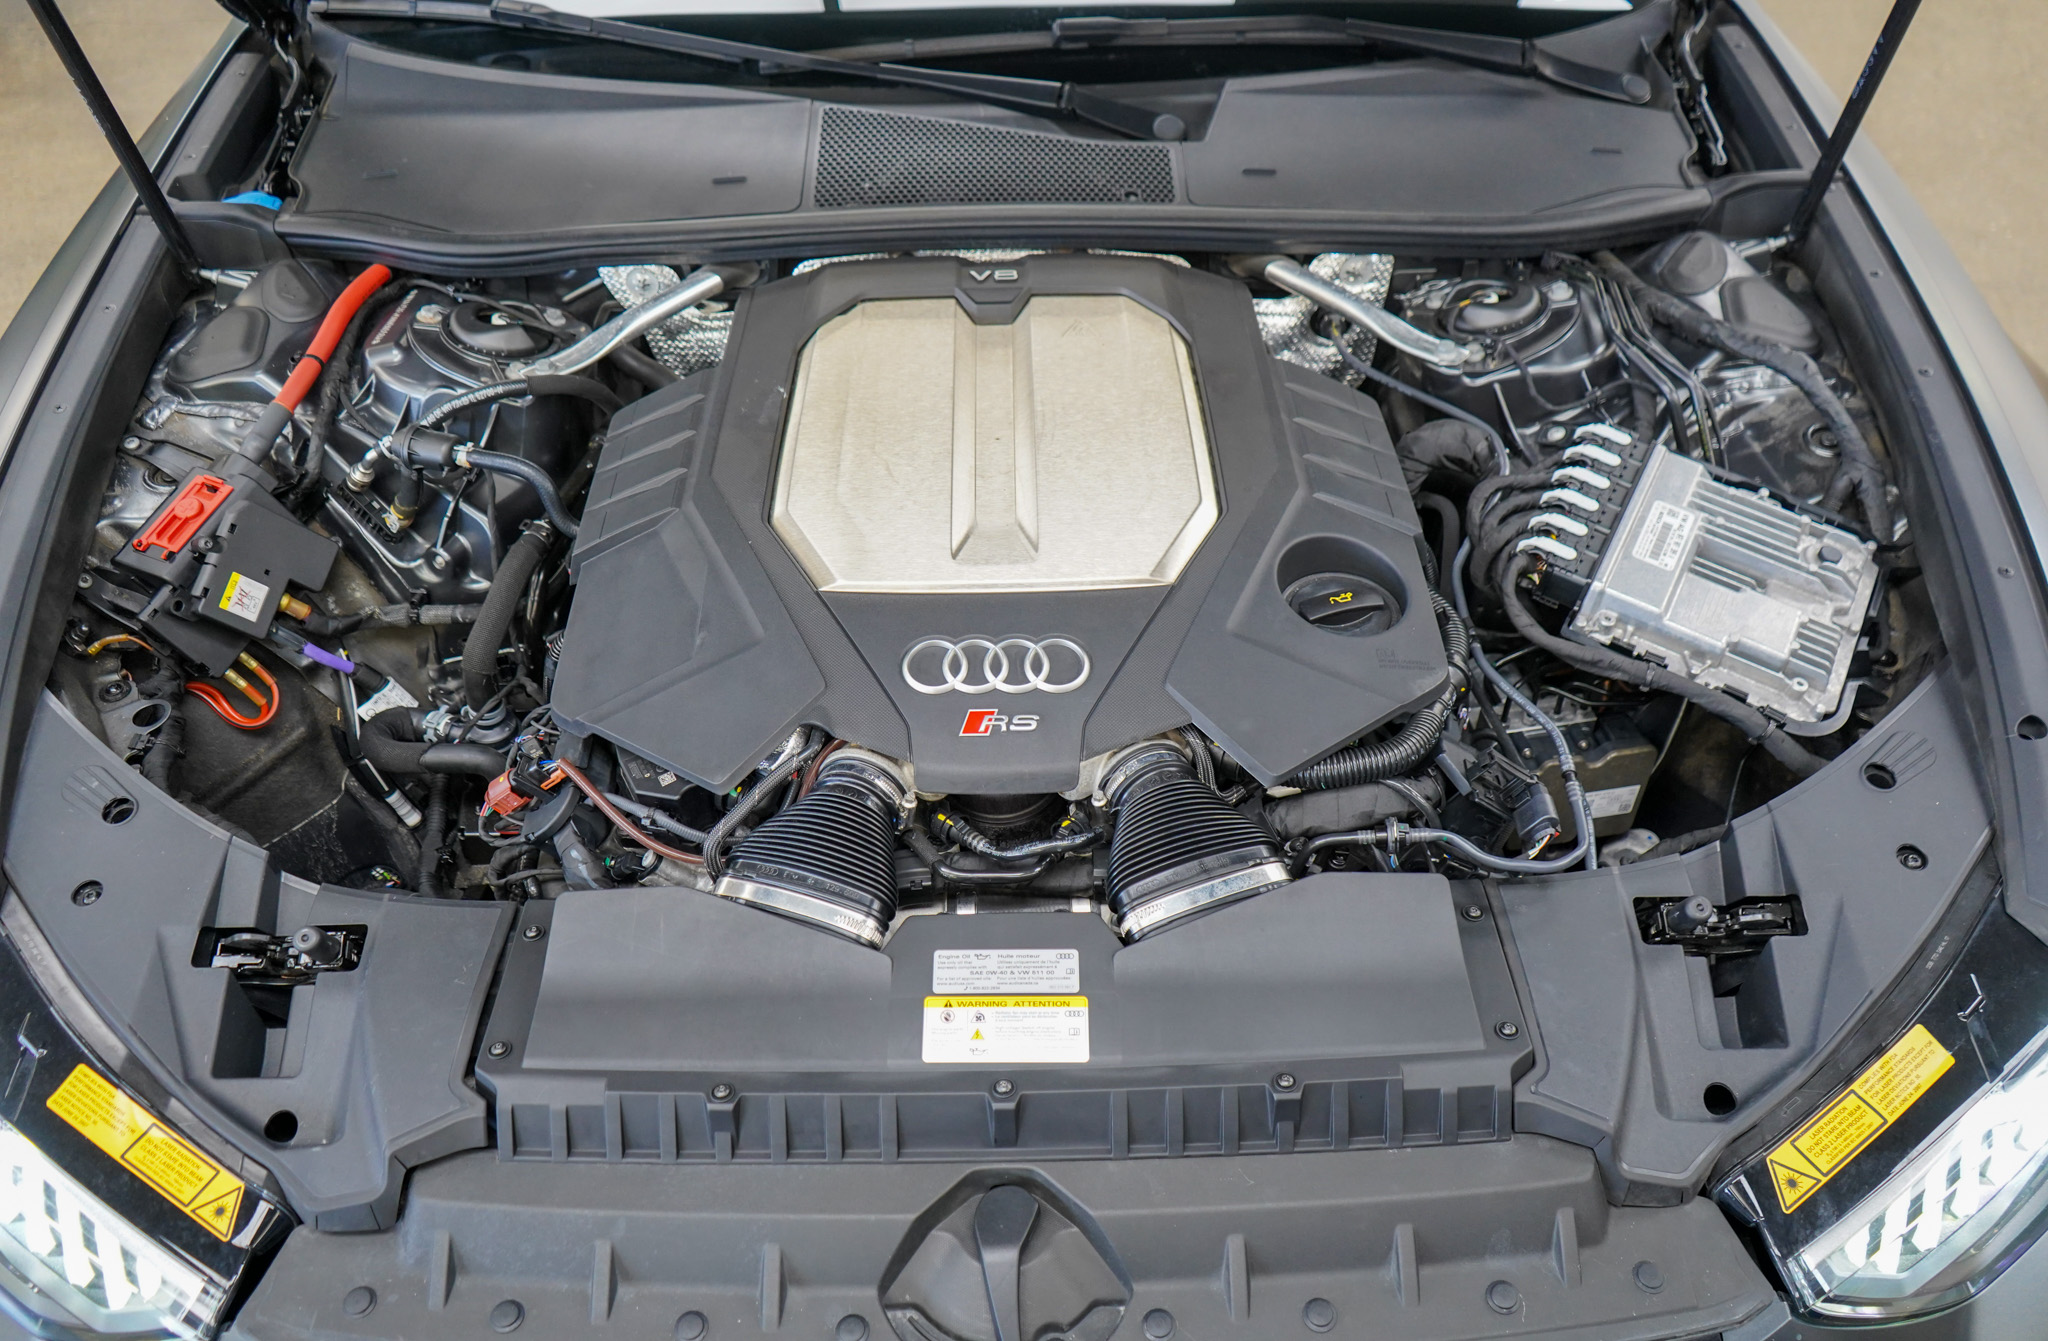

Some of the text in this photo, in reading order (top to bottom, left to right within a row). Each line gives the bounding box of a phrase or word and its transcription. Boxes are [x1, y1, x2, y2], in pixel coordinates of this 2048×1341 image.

[969, 269, 1018, 281] V8
[978, 714, 1040, 732] RS
[1858, 1052, 1898, 1090] COMPLIES WITH FDA
[1863, 1045, 1915, 1095] PERFORMANCE STANDARDS
[1870, 1039, 1933, 1100] FOR LASER PRODUCTS EXCEPT FOR
[1876, 1091, 1890, 1105] LASER
[1888, 1071, 1911, 1093] DEVIATIONS
[1909, 1053, 1930, 1073] PURSUANT
[1881, 1096, 1896, 1111] LASER
[1894, 1084, 1909, 1099] NOTICE
[1887, 1105, 1899, 1116] DATE
[1896, 1096, 1909, 1107] JUNE
[1806, 1144, 1815, 1153] DO
[1812, 1136, 1825, 1147] NOT
[1822, 1124, 1839, 1139] STARE
[1836, 1115, 1849, 1126] INTO
[1847, 1104, 1862, 1117] BEAM
[1808, 1105, 1848, 1139] LASER RADIATION
[1813, 1143, 1830, 1158] CLASS
[1830, 1127, 1848, 1142] LASER
[1845, 1109, 1868, 1130] PRODUCT
